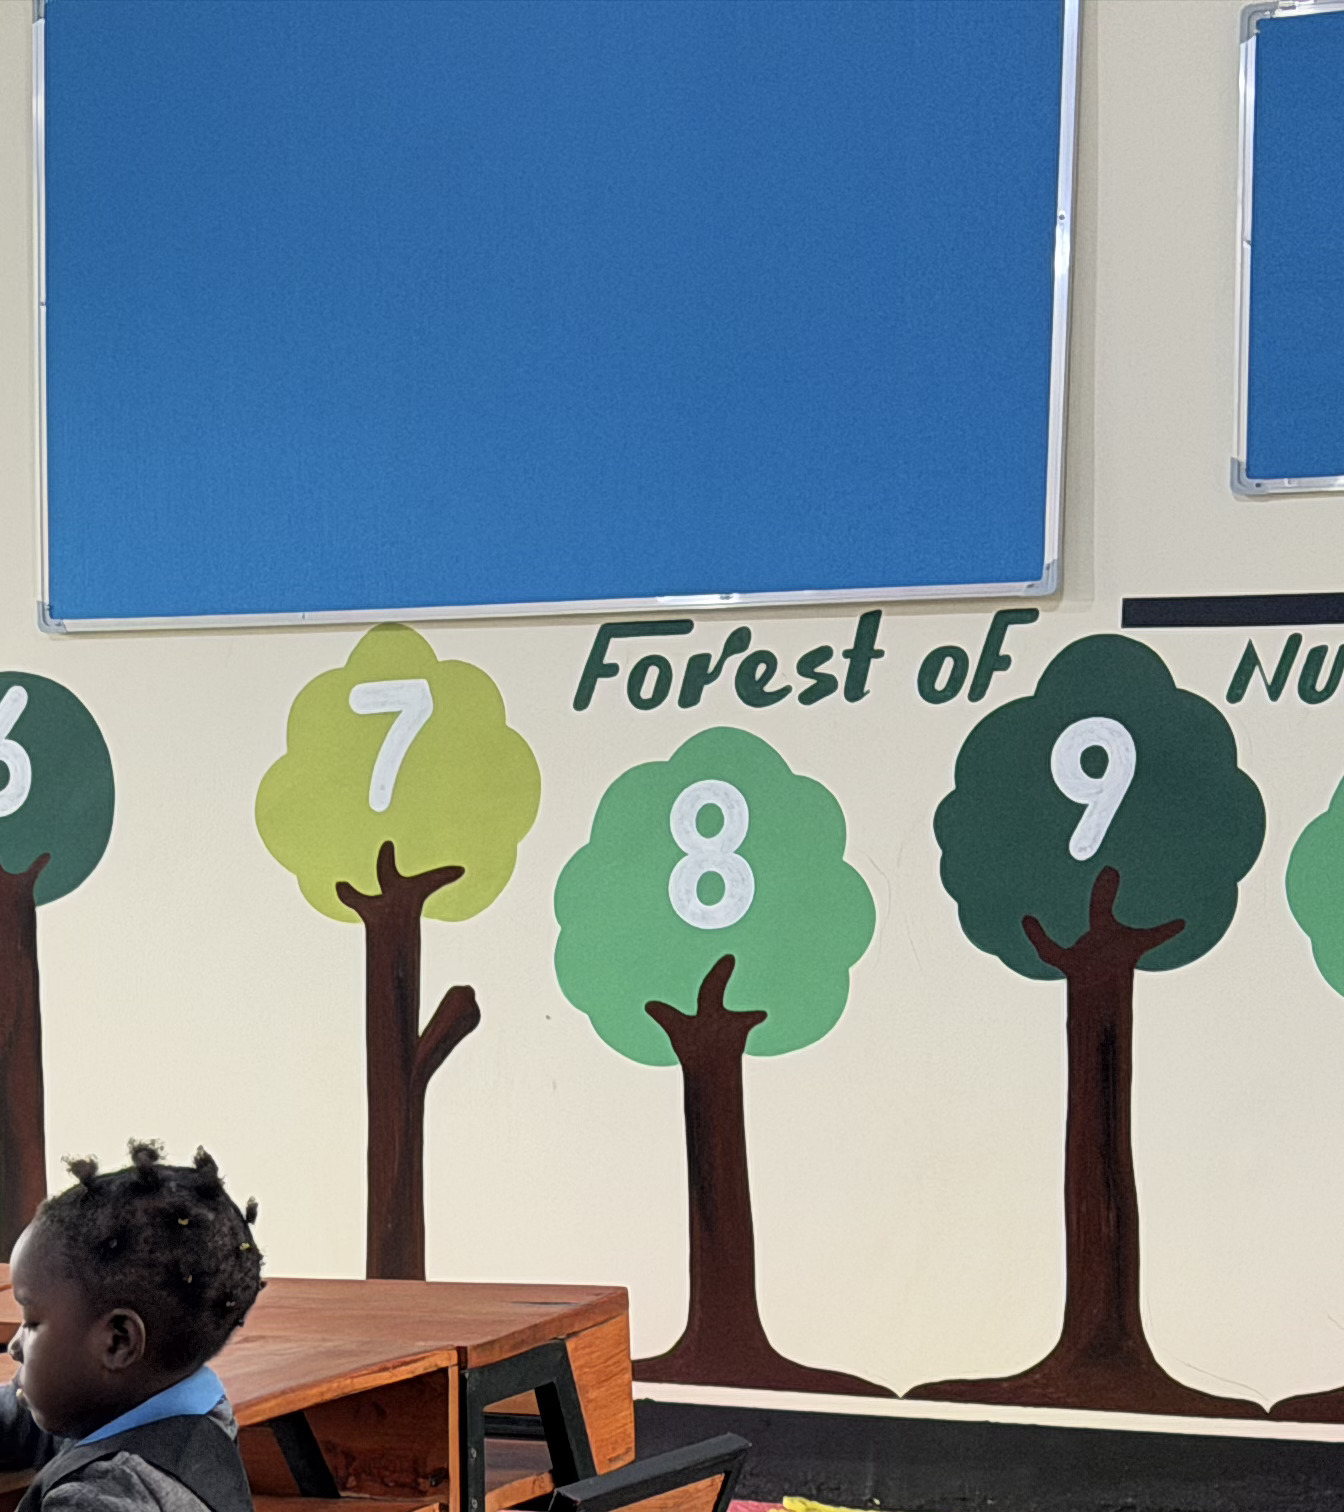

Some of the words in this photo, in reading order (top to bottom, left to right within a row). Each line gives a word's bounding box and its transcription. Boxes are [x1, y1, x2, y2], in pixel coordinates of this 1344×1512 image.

[349, 679, 433, 812] 7
[1050, 716, 1136, 861] 9
[668, 780, 756, 930] 8
